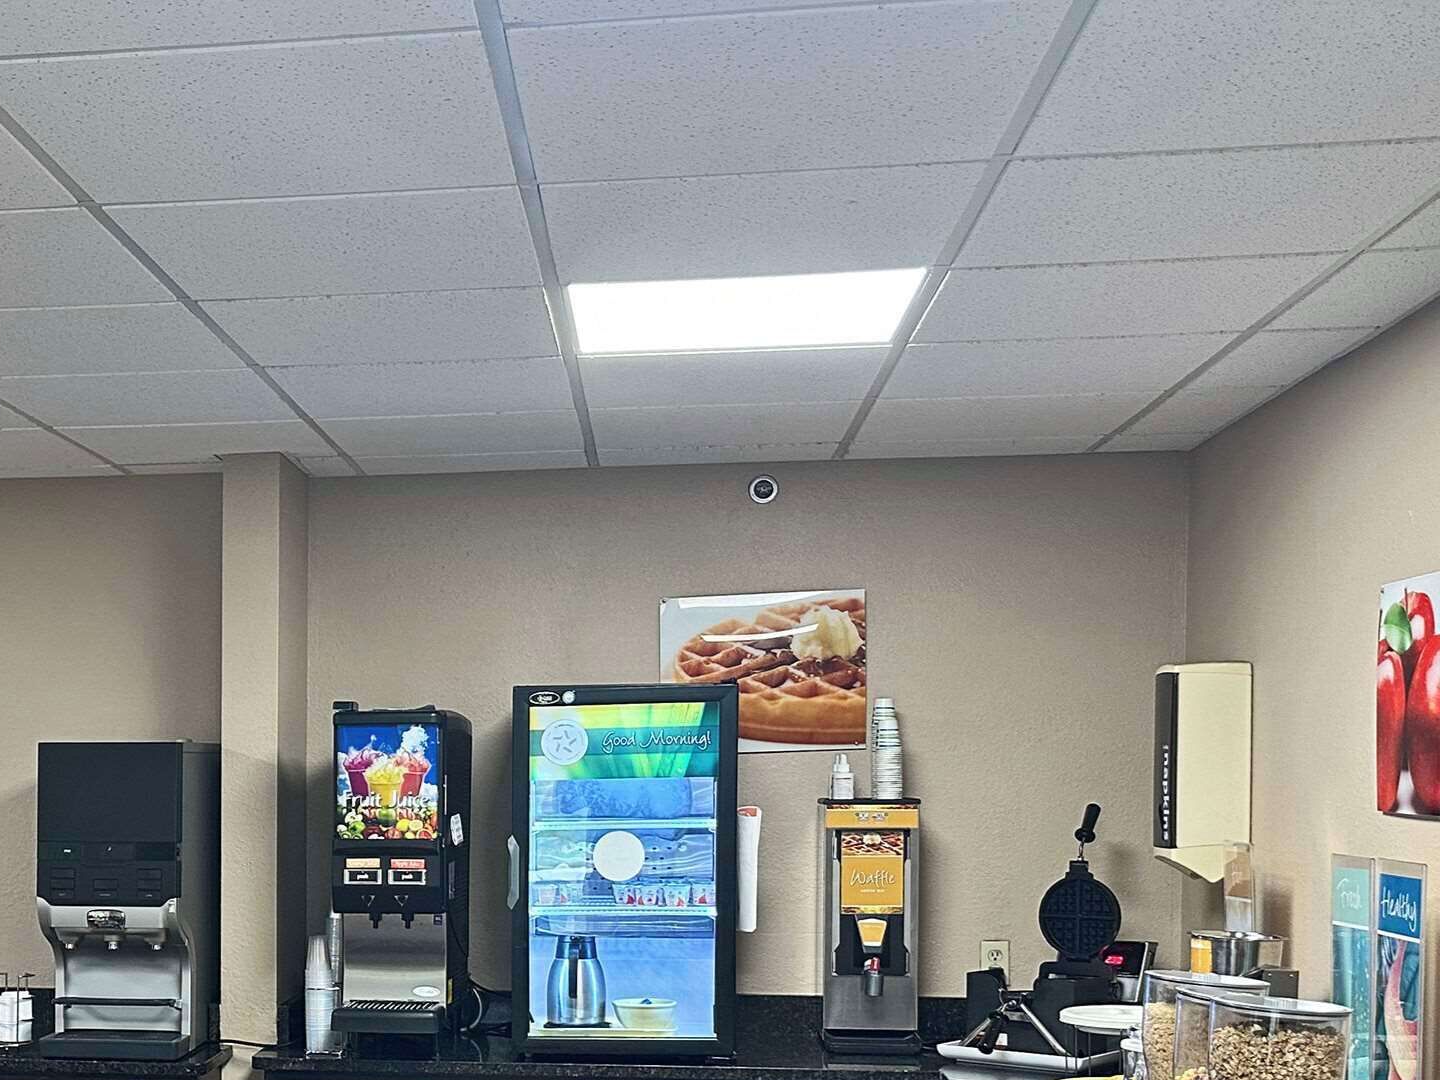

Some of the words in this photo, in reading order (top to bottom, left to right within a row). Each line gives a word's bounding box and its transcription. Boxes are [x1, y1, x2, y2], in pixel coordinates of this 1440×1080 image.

[602, 731, 635, 754] Good
[640, 730, 712, 750] Morning!
[342, 790, 382, 808] Fruit
[389, 790, 429, 808] Juice
[1162, 753, 1170, 841] napkins
[850, 869, 896, 888] Waffle
[1380, 885, 1417, 933] Healthy
